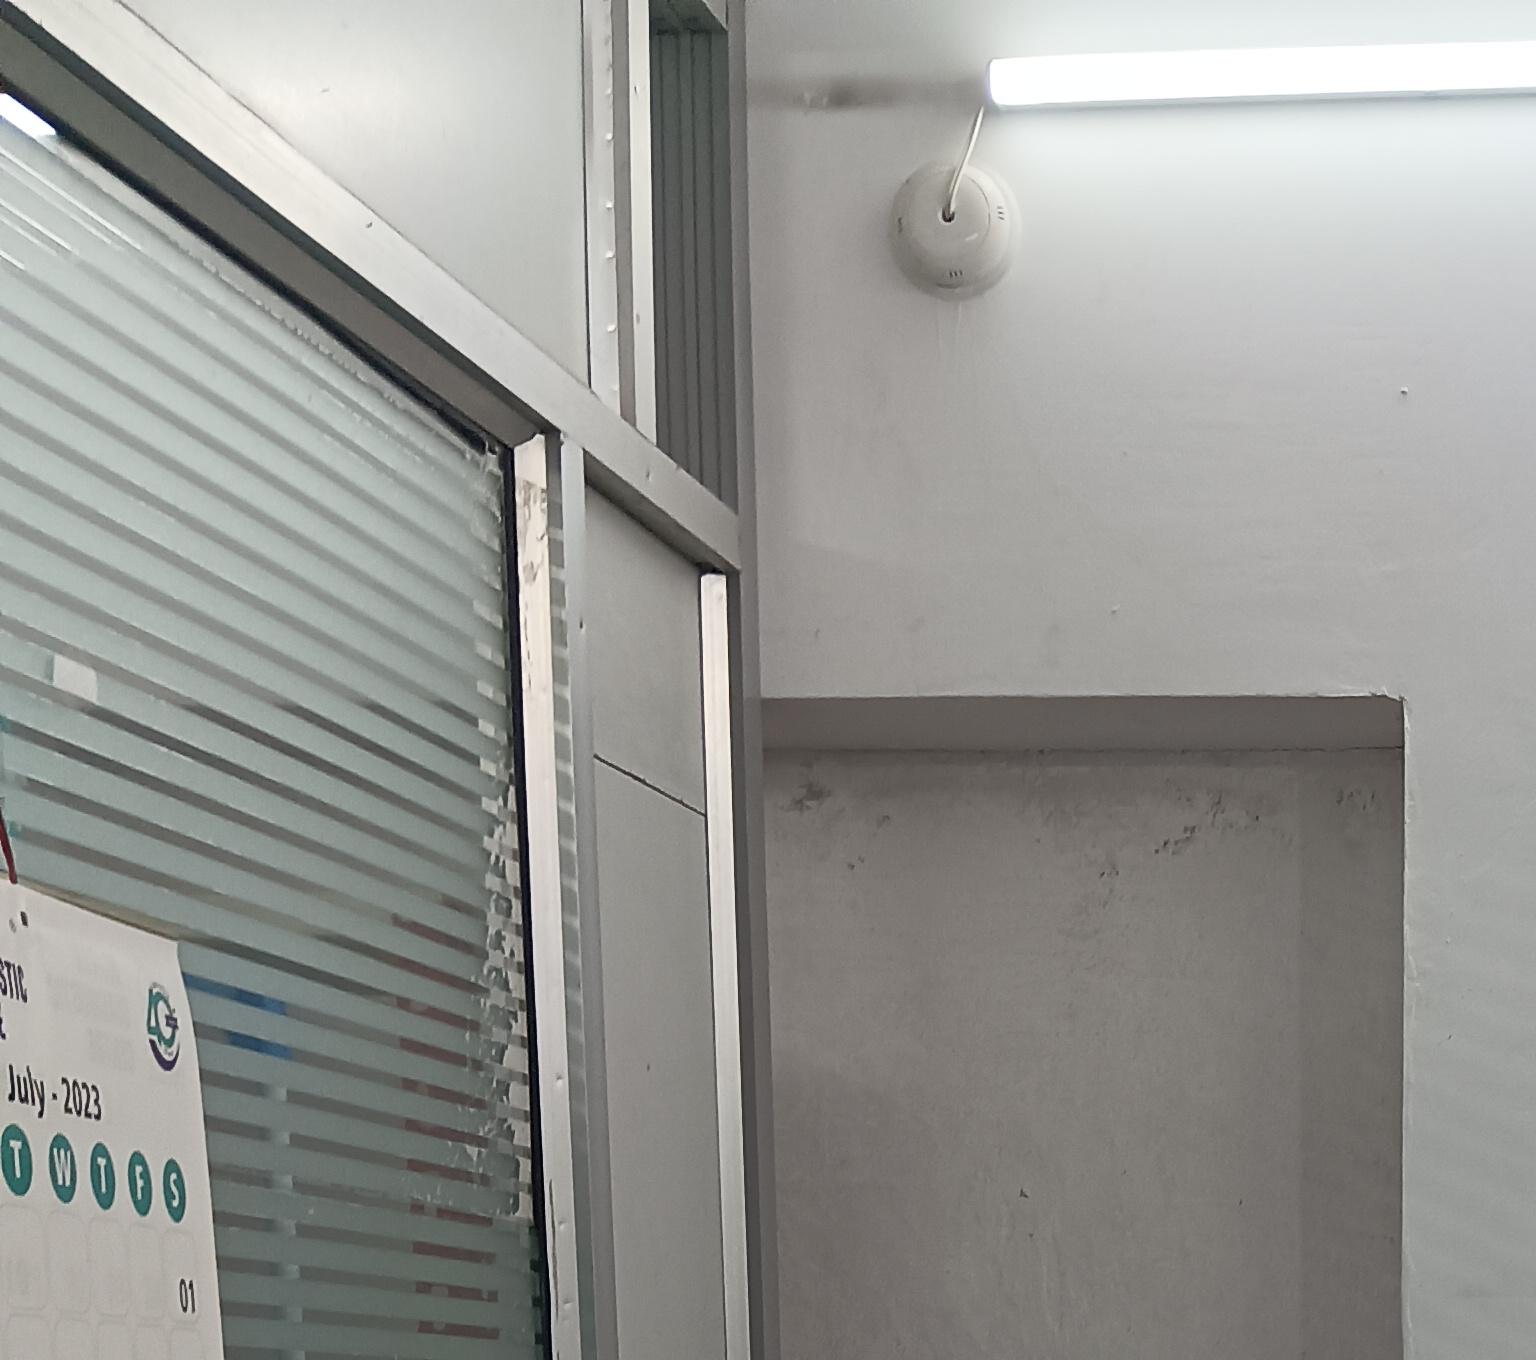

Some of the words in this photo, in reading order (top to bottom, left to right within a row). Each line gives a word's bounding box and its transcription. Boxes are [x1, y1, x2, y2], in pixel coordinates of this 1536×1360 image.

[8, 1064, 45, 1118] July
[61, 1077, 102, 1121] 2023
[9, 1140, 22, 1179] T
[53, 1147, 71, 1187] W
[97, 1157, 106, 1194] T
[135, 1165, 144, 1200] F
[170, 1173, 180, 1207] S
[179, 1278, 195, 1314] 01
